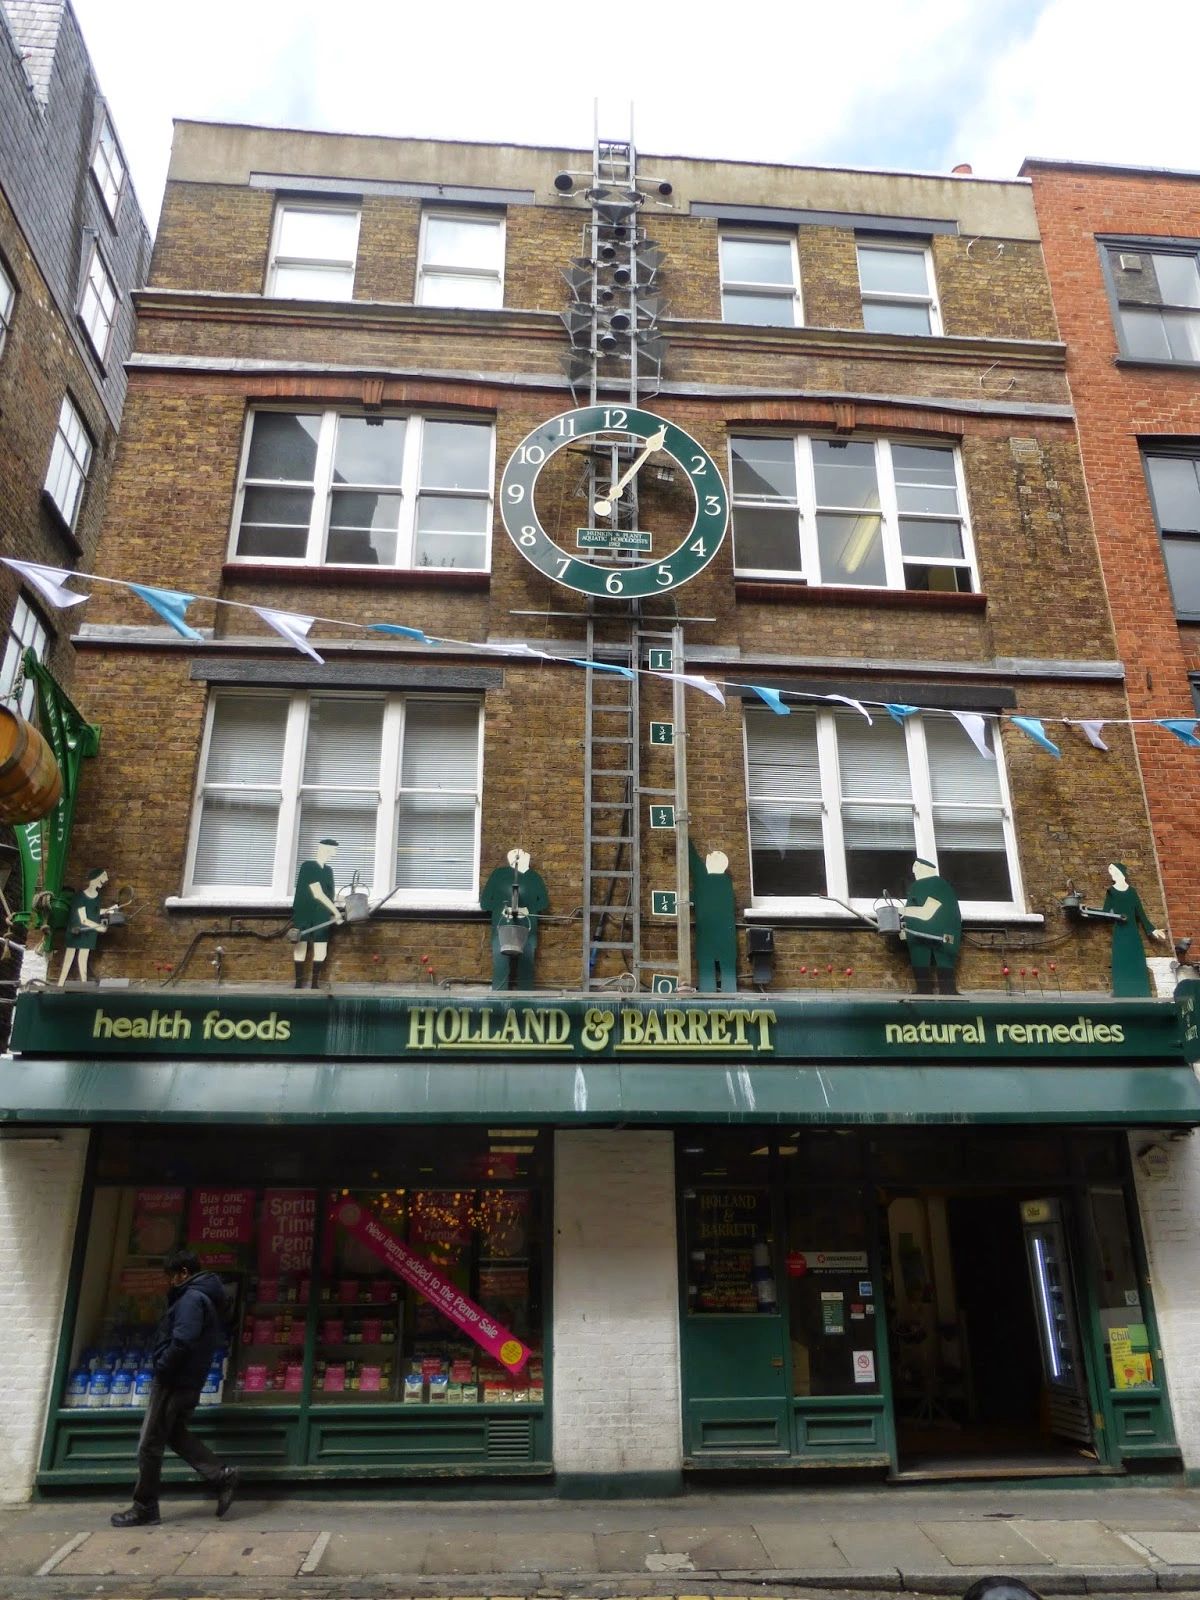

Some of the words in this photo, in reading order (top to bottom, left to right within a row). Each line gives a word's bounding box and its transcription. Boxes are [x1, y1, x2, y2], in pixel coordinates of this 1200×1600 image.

[558, 418, 575, 437] 11
[603, 410, 628, 429] 12
[519, 446, 545, 464] 10
[691, 456, 707, 475] 2
[507, 484, 525, 504] 9
[704, 495, 721, 515] 3
[520, 526, 537, 546] 8
[690, 536, 706, 557] 4
[556, 558, 572, 579] 7
[656, 565, 673, 585] 5
[606, 573, 623, 594] 6
[657, 653, 664, 667] 1
[92, 1009, 192, 1039] health
[202, 1010, 291, 1040] foods
[406, 1007, 574, 1049] HOLLAND
[581, 1008, 614, 1050] &
[618, 1009, 777, 1050] BARRETT
[885, 1016, 986, 1044] natural
[995, 1016, 1125, 1044] remedies
[223, 1205, 243, 1215] one
[270, 1196, 316, 1216] Sprin
[209, 1216, 224, 1226] for
[227, 1217, 234, 1226] a
[271, 1235, 314, 1253] Penn
[366, 1222, 385, 1240] New
[406, 1257, 431, 1279] added
[430, 1278, 440, 1287] to
[440, 1285, 454, 1299] the
[453, 1297, 480, 1321] Penny
[478, 1318, 498, 1337] Sale
